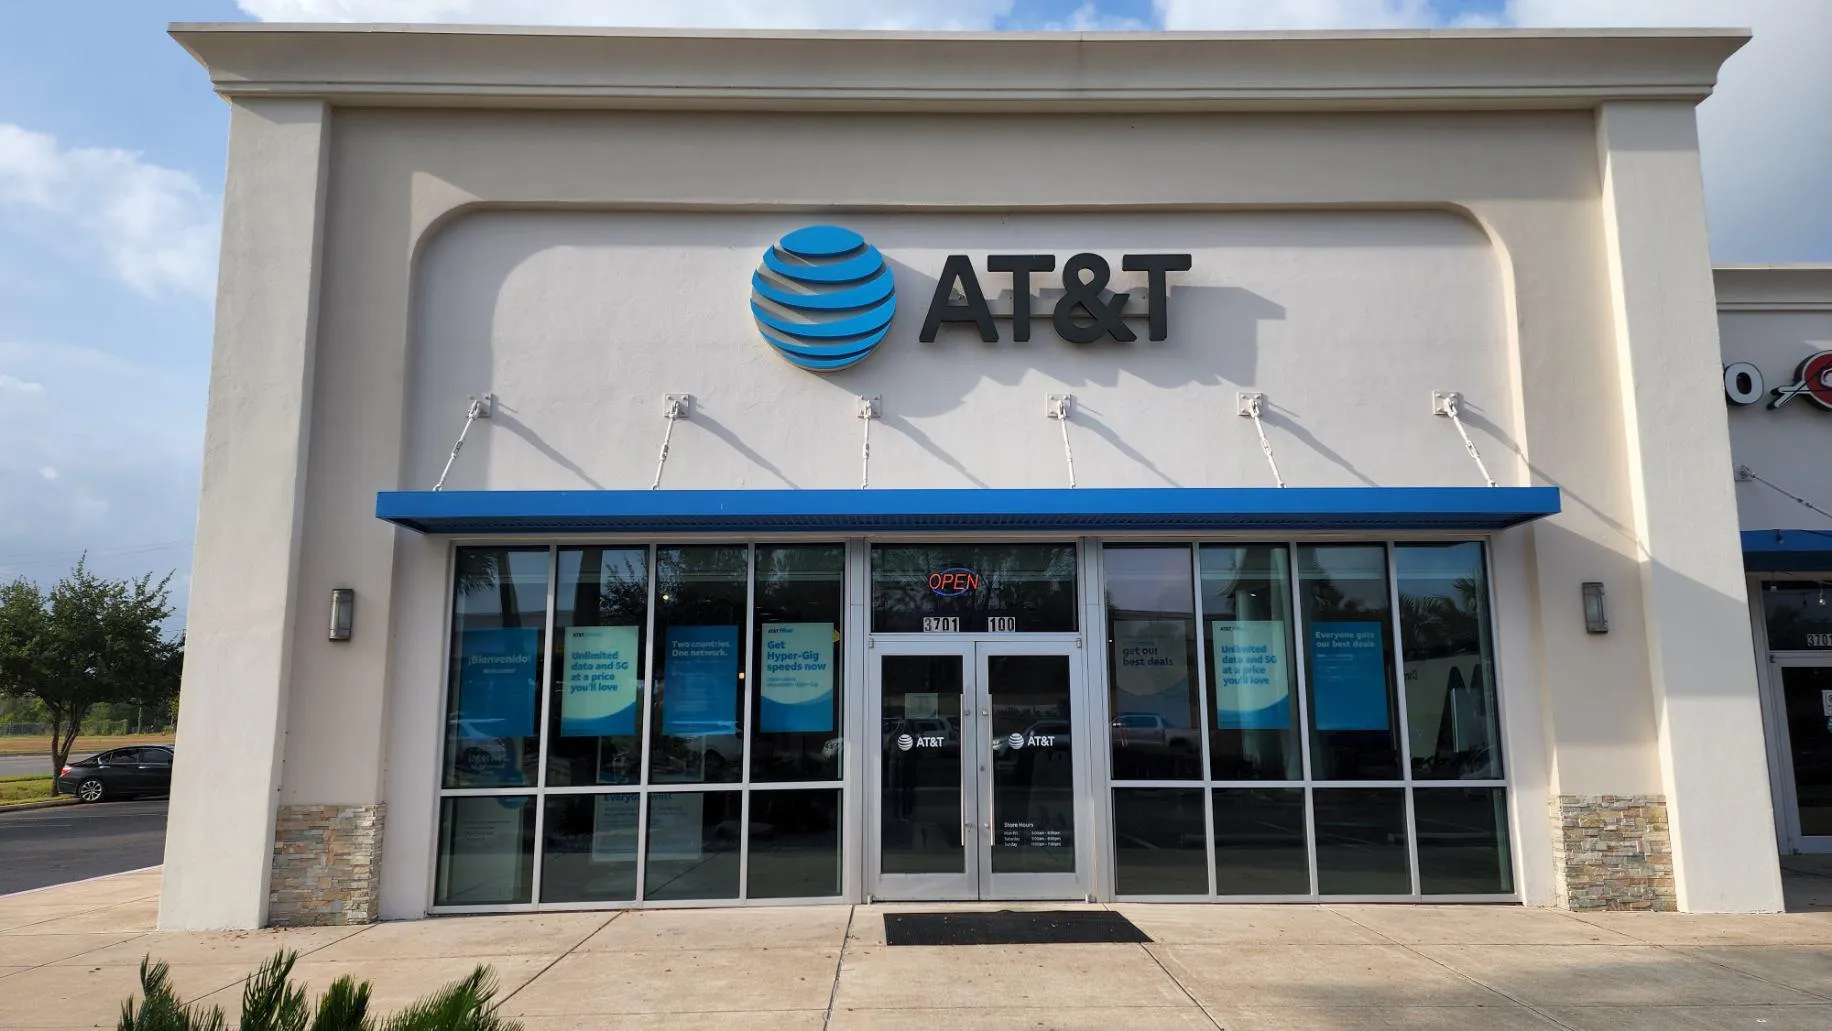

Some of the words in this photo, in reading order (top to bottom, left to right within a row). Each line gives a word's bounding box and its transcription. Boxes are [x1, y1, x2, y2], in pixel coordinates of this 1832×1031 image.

[919, 252, 1192, 343] AT&T
[929, 573, 979, 590] OPEN
[924, 617, 959, 632] 3701
[989, 617, 1015, 632] 100
[1315, 631, 1354, 640] Everyone
[672, 640, 690, 648] Two
[691, 640, 732, 648] countries.
[767, 641, 786, 650] Get
[1332, 640, 1350, 648] best
[1352, 640, 1375, 648] deals
[672, 649, 689, 657] One
[690, 649, 728, 657] network.
[1123, 647, 1140, 657] get
[1221, 645, 1267, 654] Unlimited
[571, 651, 619, 660] Unlimited
[767, 651, 819, 662] Hyper-Gig
[1222, 655, 1243, 664] data
[1245, 655, 1263, 664] and
[571, 661, 593, 670] data
[595, 661, 613, 670] and
[615, 661, 628, 670] 5G
[1123, 657, 1145, 666] best
[1147, 657, 1173, 666] deals
[767, 662, 803, 673] speeds
[804, 663, 827, 671] now
[1222, 666, 1232, 674] at
[571, 673, 581, 681] at
[591, 672, 615, 683] price
[570, 683, 596, 694] you'll
[598, 683, 618, 692] love
[916, 736, 944, 748] AT&T
[1027, 736, 1055, 747] AT&T
